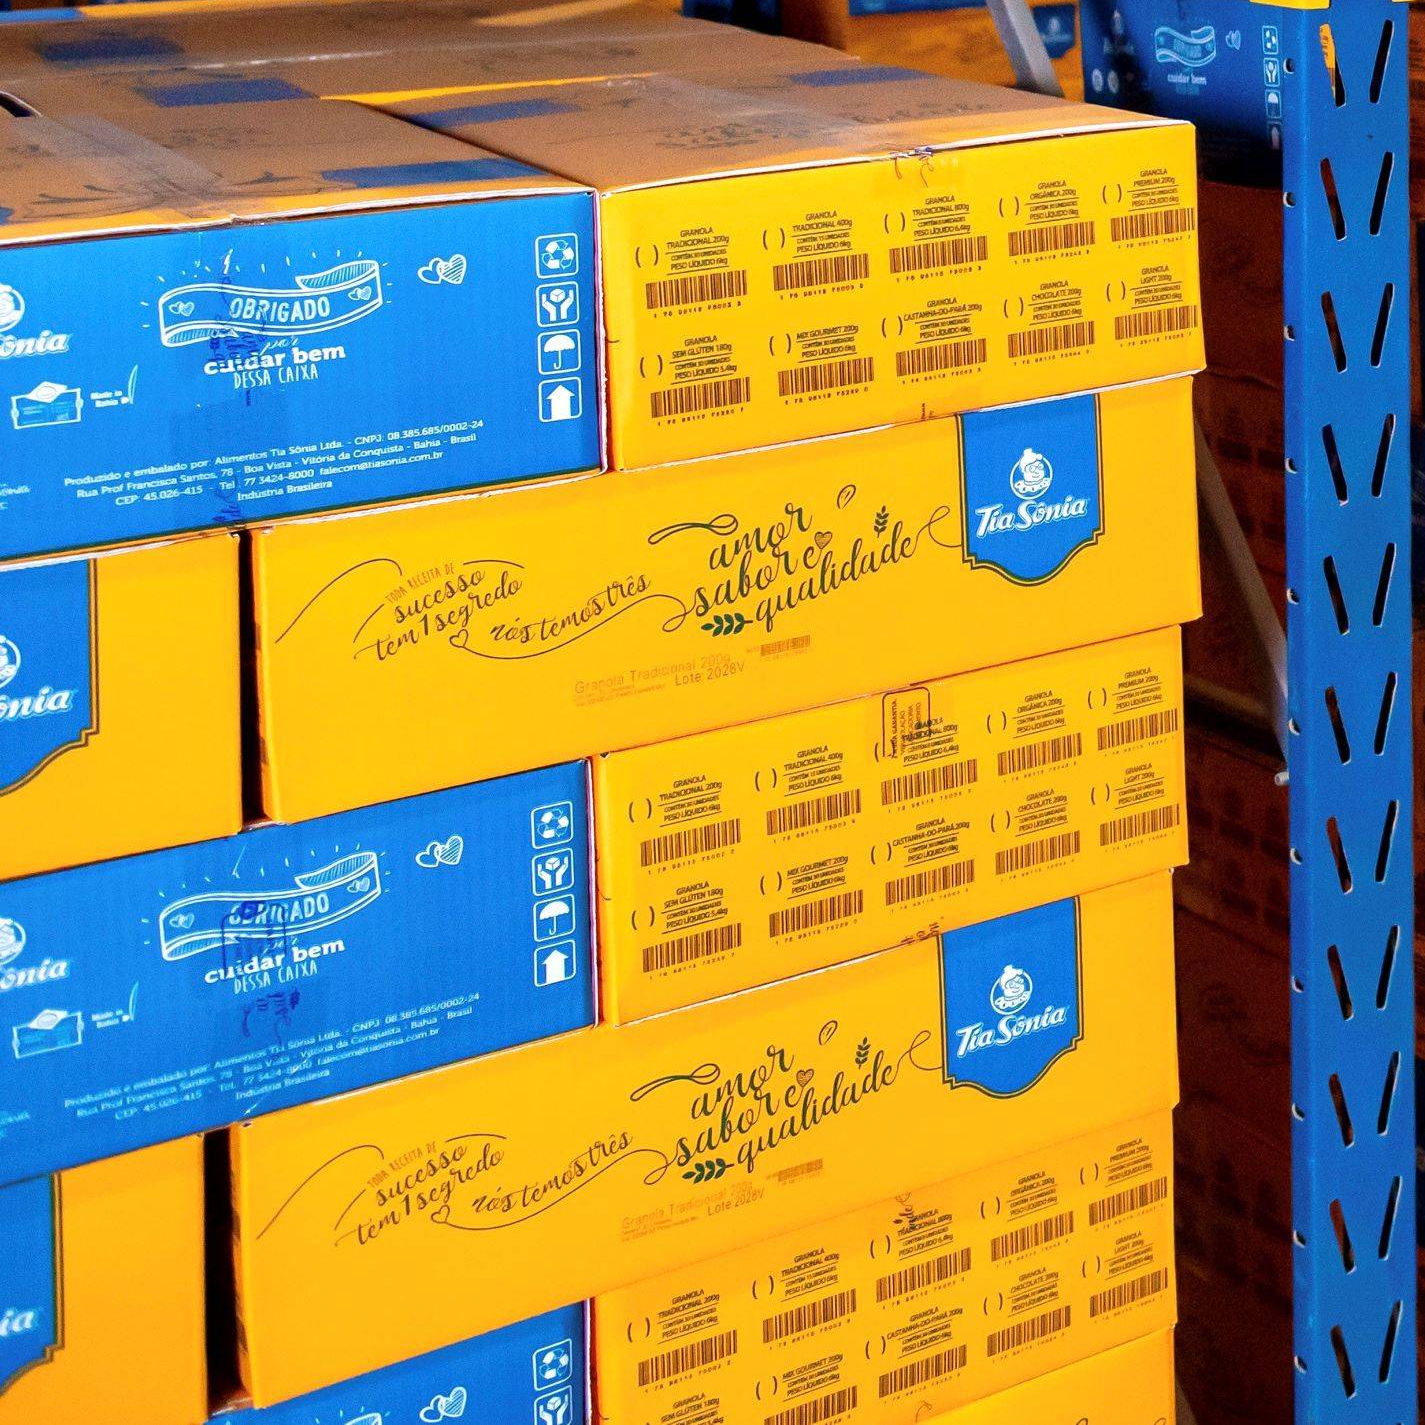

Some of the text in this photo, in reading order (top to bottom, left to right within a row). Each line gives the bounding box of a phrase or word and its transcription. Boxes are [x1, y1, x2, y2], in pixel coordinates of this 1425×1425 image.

[229, 296, 331, 323] OBRIGADO
[204, 345, 346, 375] cuidar bem
[234, 363, 319, 389] DESSA CAIXA
[64, 472, 121, 486] Produzido
[134, 462, 187, 477] embalado
[215, 451, 267, 465] Alimentos
[270, 447, 285, 457] Tia
[77, 489, 98, 499] Rua
[127, 477, 177, 491] Francisca
[221, 468, 233, 477] 78
[245, 465, 263, 474] Boa
[266, 460, 291, 471] Vista
[302, 453, 335, 466] Vitória
[339, 450, 350, 460] da
[354, 445, 403, 459] Conquista
[414, 438, 440, 450] Bahia
[450, 433, 476, 444] Brasil
[245, 477, 255, 486] 77
[259, 468, 314, 485] 3424-8000
[287, 480, 332, 493] Brasileira
[709, 502, 813, 571] amor
[975, 495, 1088, 538] Tia Sônia
[386, 585, 408, 605] TODA
[407, 567, 441, 590] RECEITA
[394, 568, 485, 624] sucesso
[539, 598, 605, 641] temos
[605, 574, 651, 608] três
[694, 545, 820, 618] sabor e
[756, 520, 916, 633] qualidade
[374, 570, 522, 661] tem 1 segredo
[956, 1005, 1068, 1058] Tia Sônia
[691, 1044, 794, 1120] amor
[737, 1050, 897, 1174] qualidade
[676, 1088, 779, 1167] sabor
[375, 1144, 468, 1207] sucesso
[417, 1142, 505, 1211] segredo
